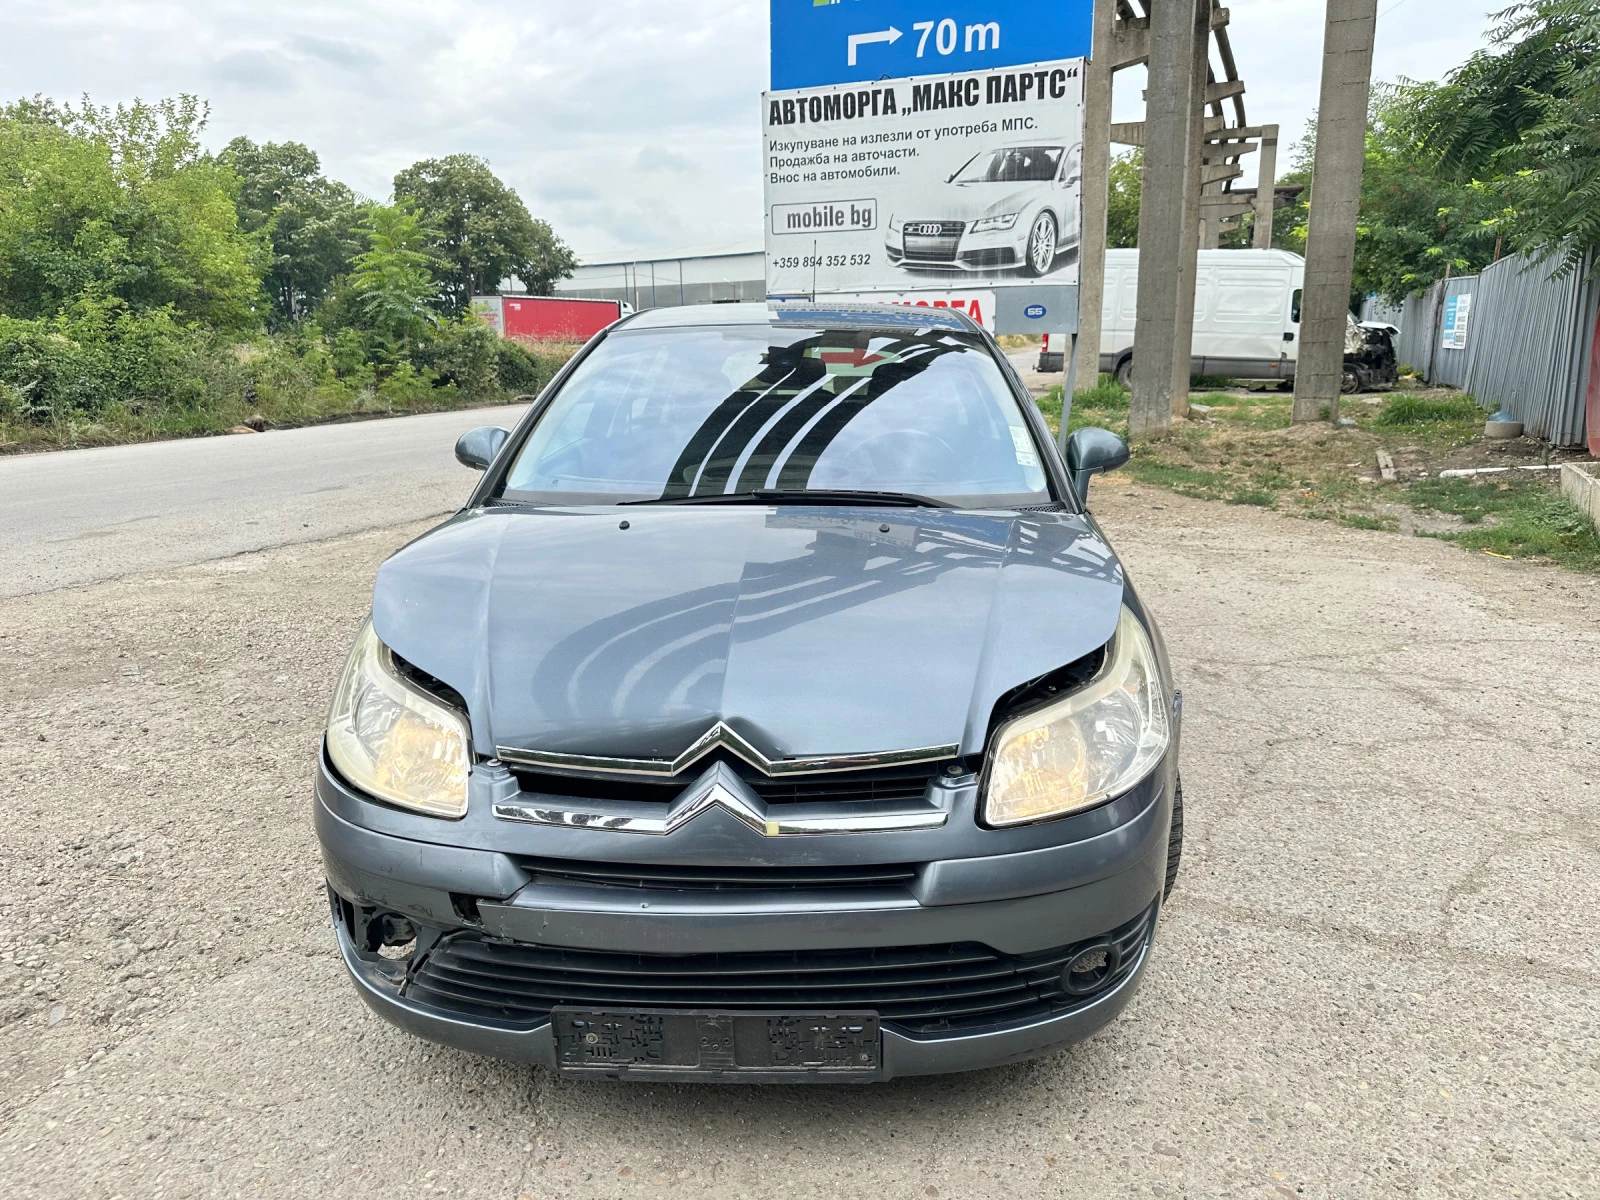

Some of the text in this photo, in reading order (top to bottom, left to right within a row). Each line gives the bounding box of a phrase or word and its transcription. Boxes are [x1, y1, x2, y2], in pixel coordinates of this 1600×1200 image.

[913, 18, 1000, 58] 70 m
[768, 88, 897, 126] АВТОМОРГА
[901, 79, 979, 117] „МАКС
[769, 117, 1038, 153] Изкупуване на излезли от употреба МПС.
[769, 147, 920, 170] Продажба на авточасти.
[770, 165, 900, 184] Внос на автомобили.
[787, 203, 872, 229] mobile bg
[773, 254, 871, 268] +359 894 352 532
